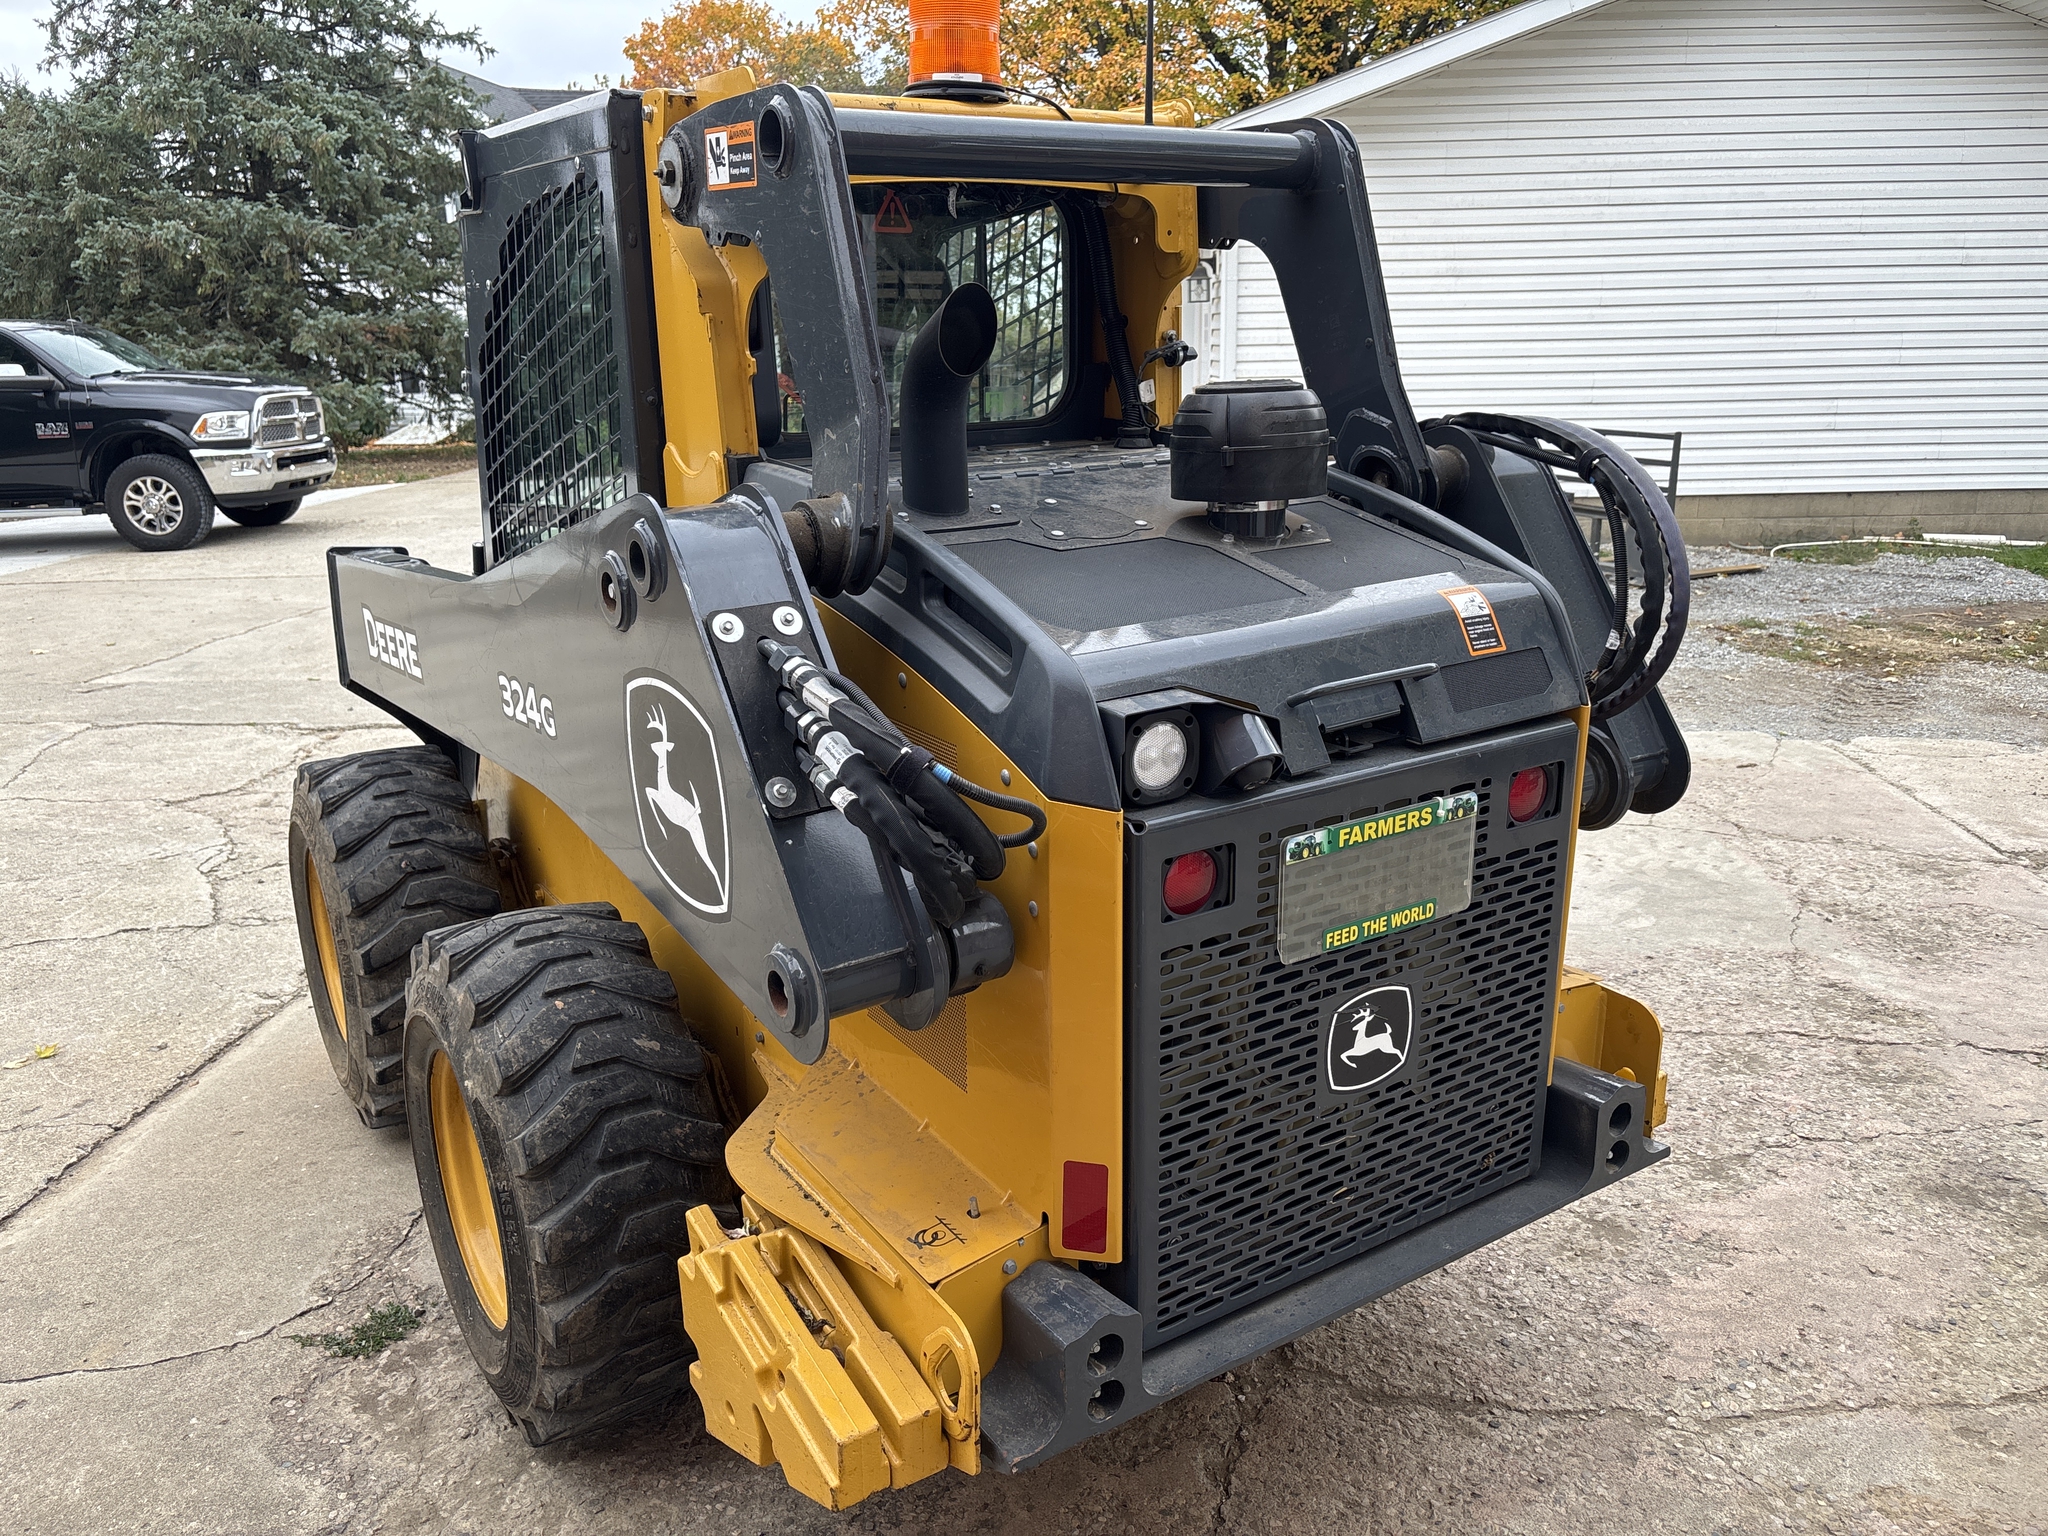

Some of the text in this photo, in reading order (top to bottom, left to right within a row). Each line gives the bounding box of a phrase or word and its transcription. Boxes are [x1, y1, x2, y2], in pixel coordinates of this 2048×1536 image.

[733, 128, 752, 139] WARNING
[730, 152, 752, 162] Pinch Area
[730, 166, 750, 176] Keep Away
[362, 607, 423, 680] DEERE
[498, 674, 557, 737] 324G
[1338, 807, 1433, 849] FARMERS
[1325, 902, 1435, 950] FEED THE WORLD
